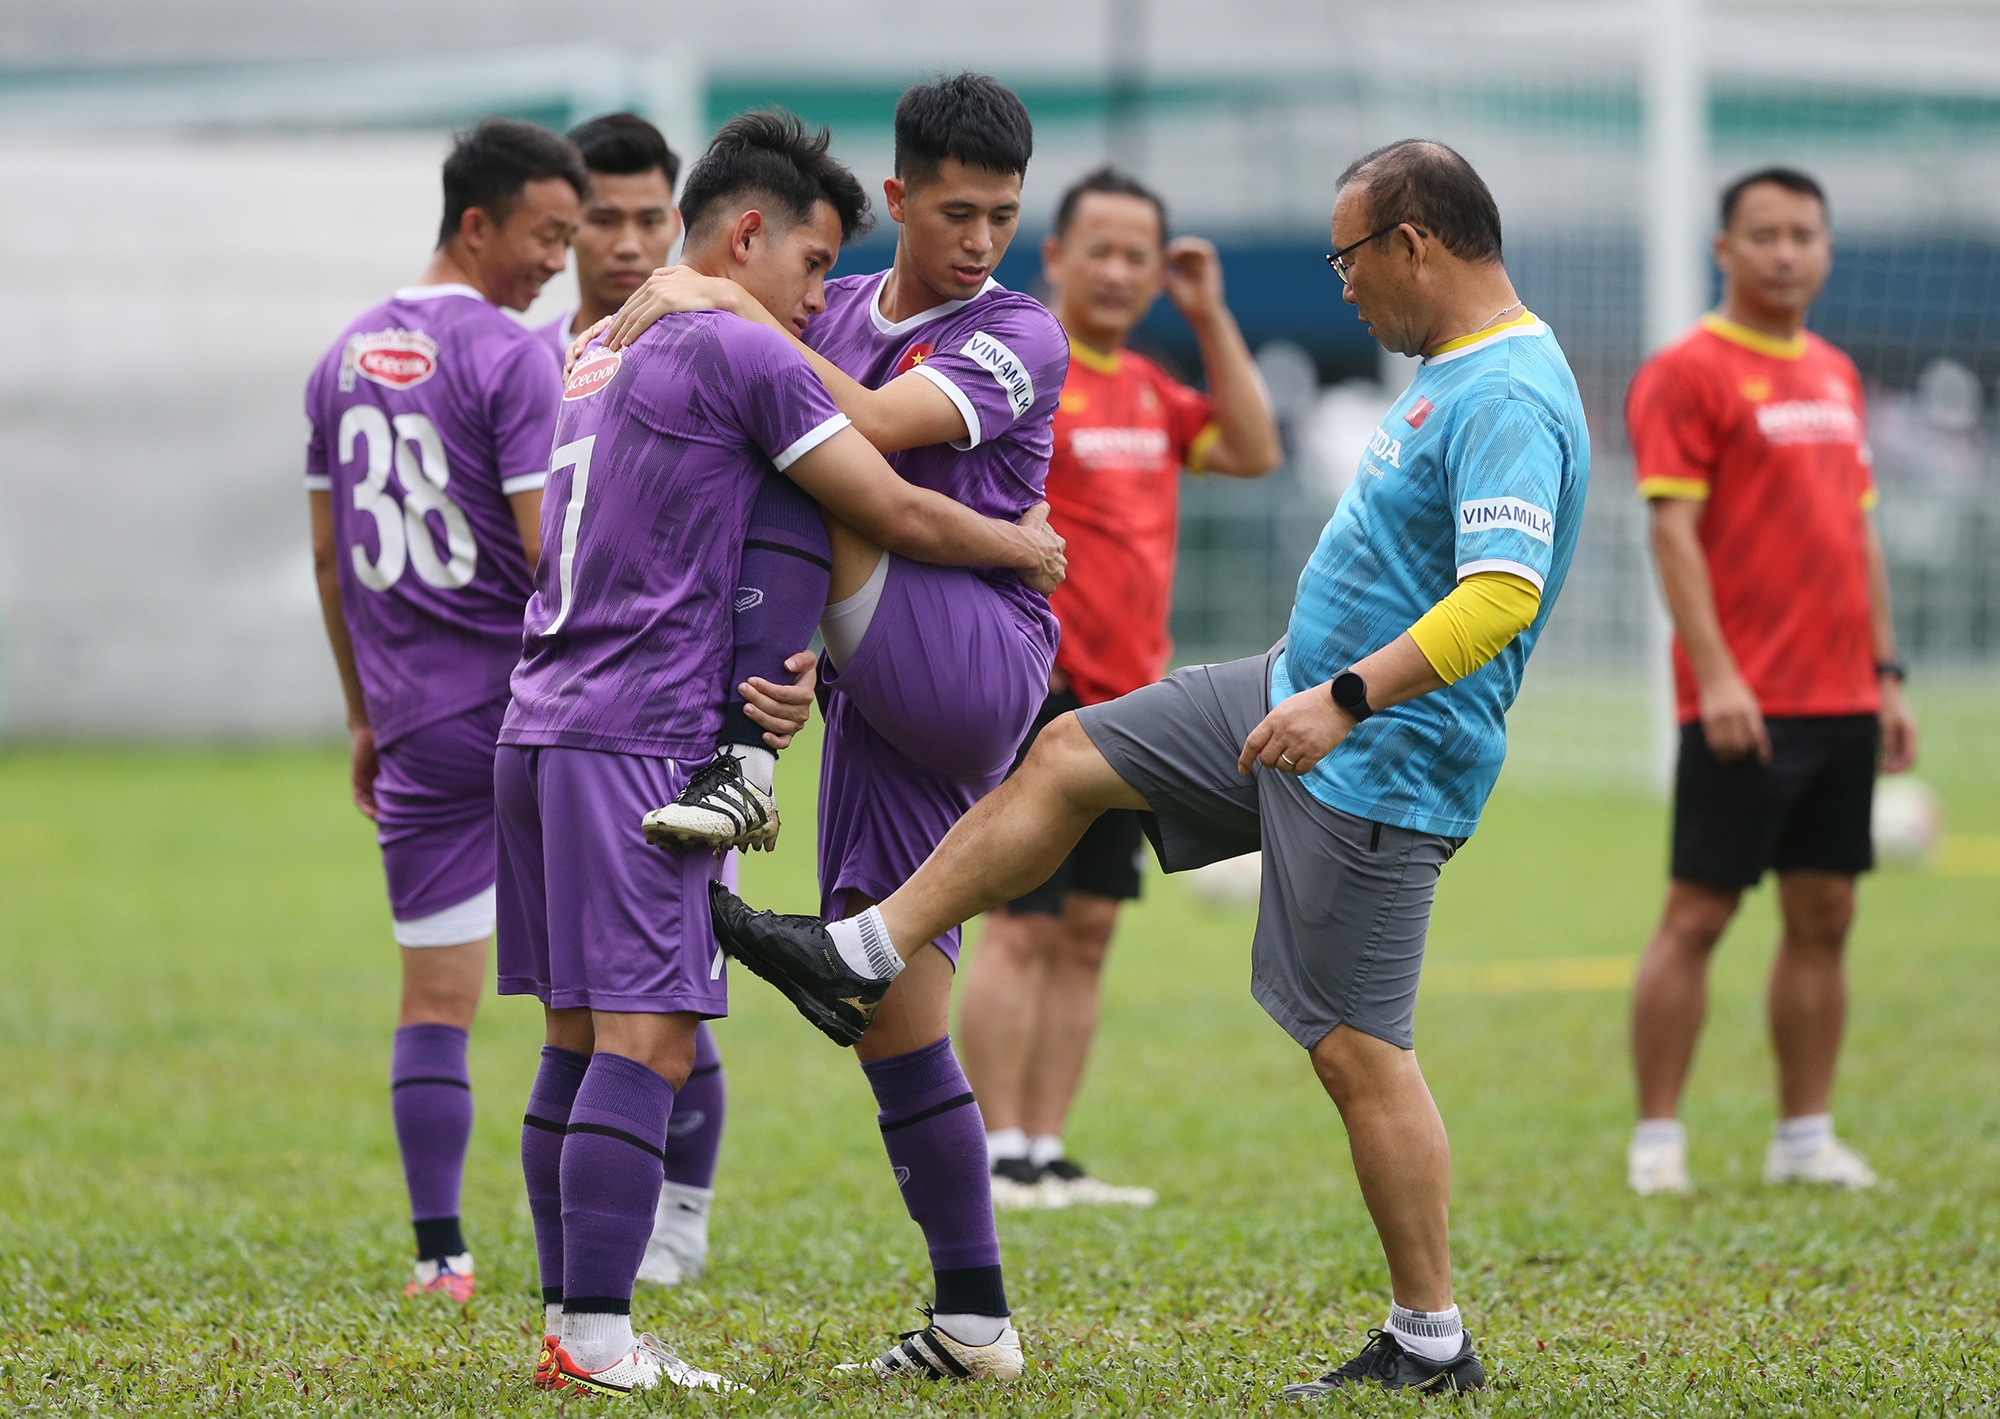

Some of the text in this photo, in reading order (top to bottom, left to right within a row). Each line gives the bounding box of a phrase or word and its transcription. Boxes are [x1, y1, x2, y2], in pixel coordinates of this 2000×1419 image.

[566, 362, 618, 391] ACECOOK
[971, 338, 1030, 415] VINAMILK
[338, 404, 477, 592] 38
[543, 434, 596, 635] 7
[1463, 504, 1551, 537] VINAMILK
